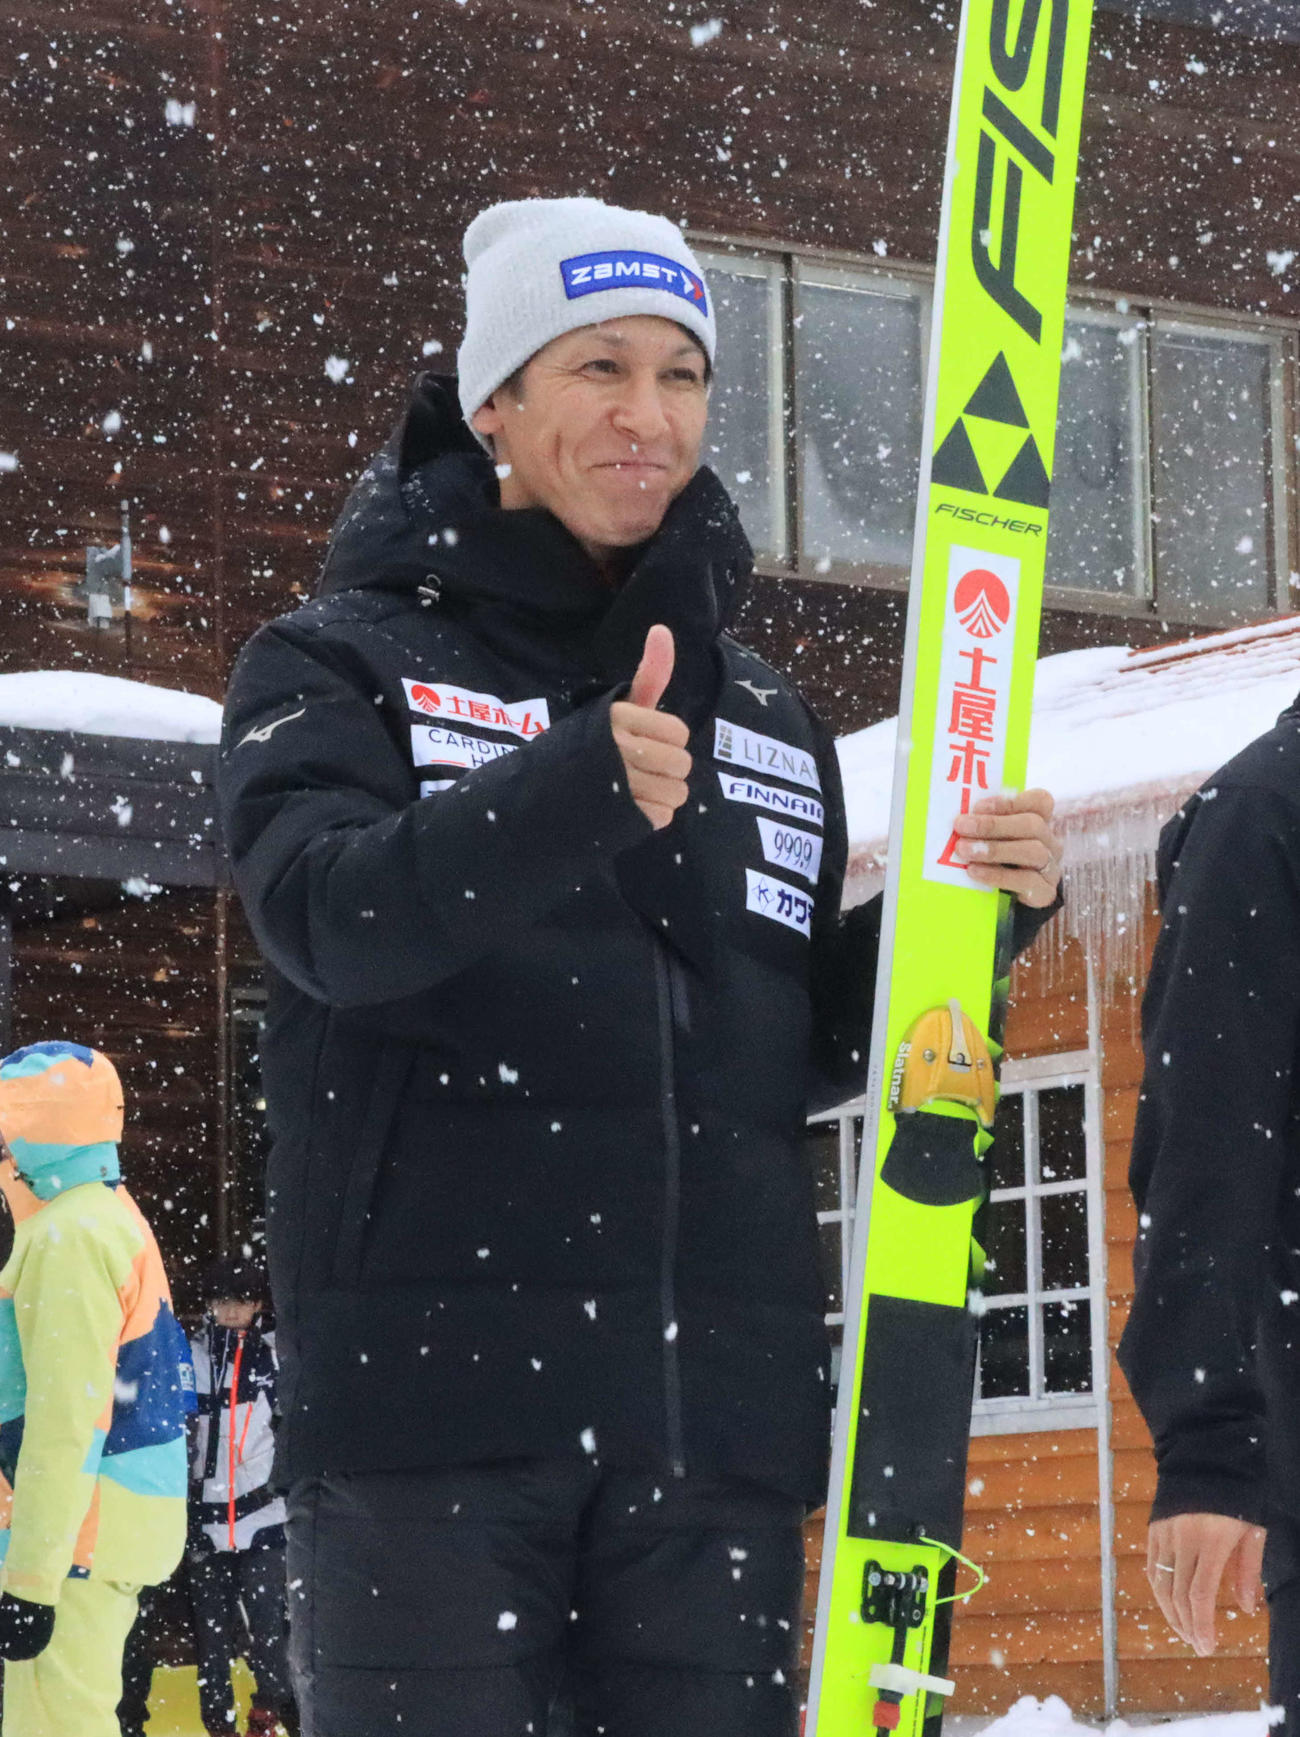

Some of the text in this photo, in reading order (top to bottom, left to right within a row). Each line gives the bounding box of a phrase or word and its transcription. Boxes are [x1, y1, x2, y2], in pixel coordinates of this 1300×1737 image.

[935, 503, 1042, 536] FISCHER
[446, 696, 546, 734] 土屋ホーム
[744, 738, 816, 781] LIZNA
[774, 830, 812, 870] 999.9
